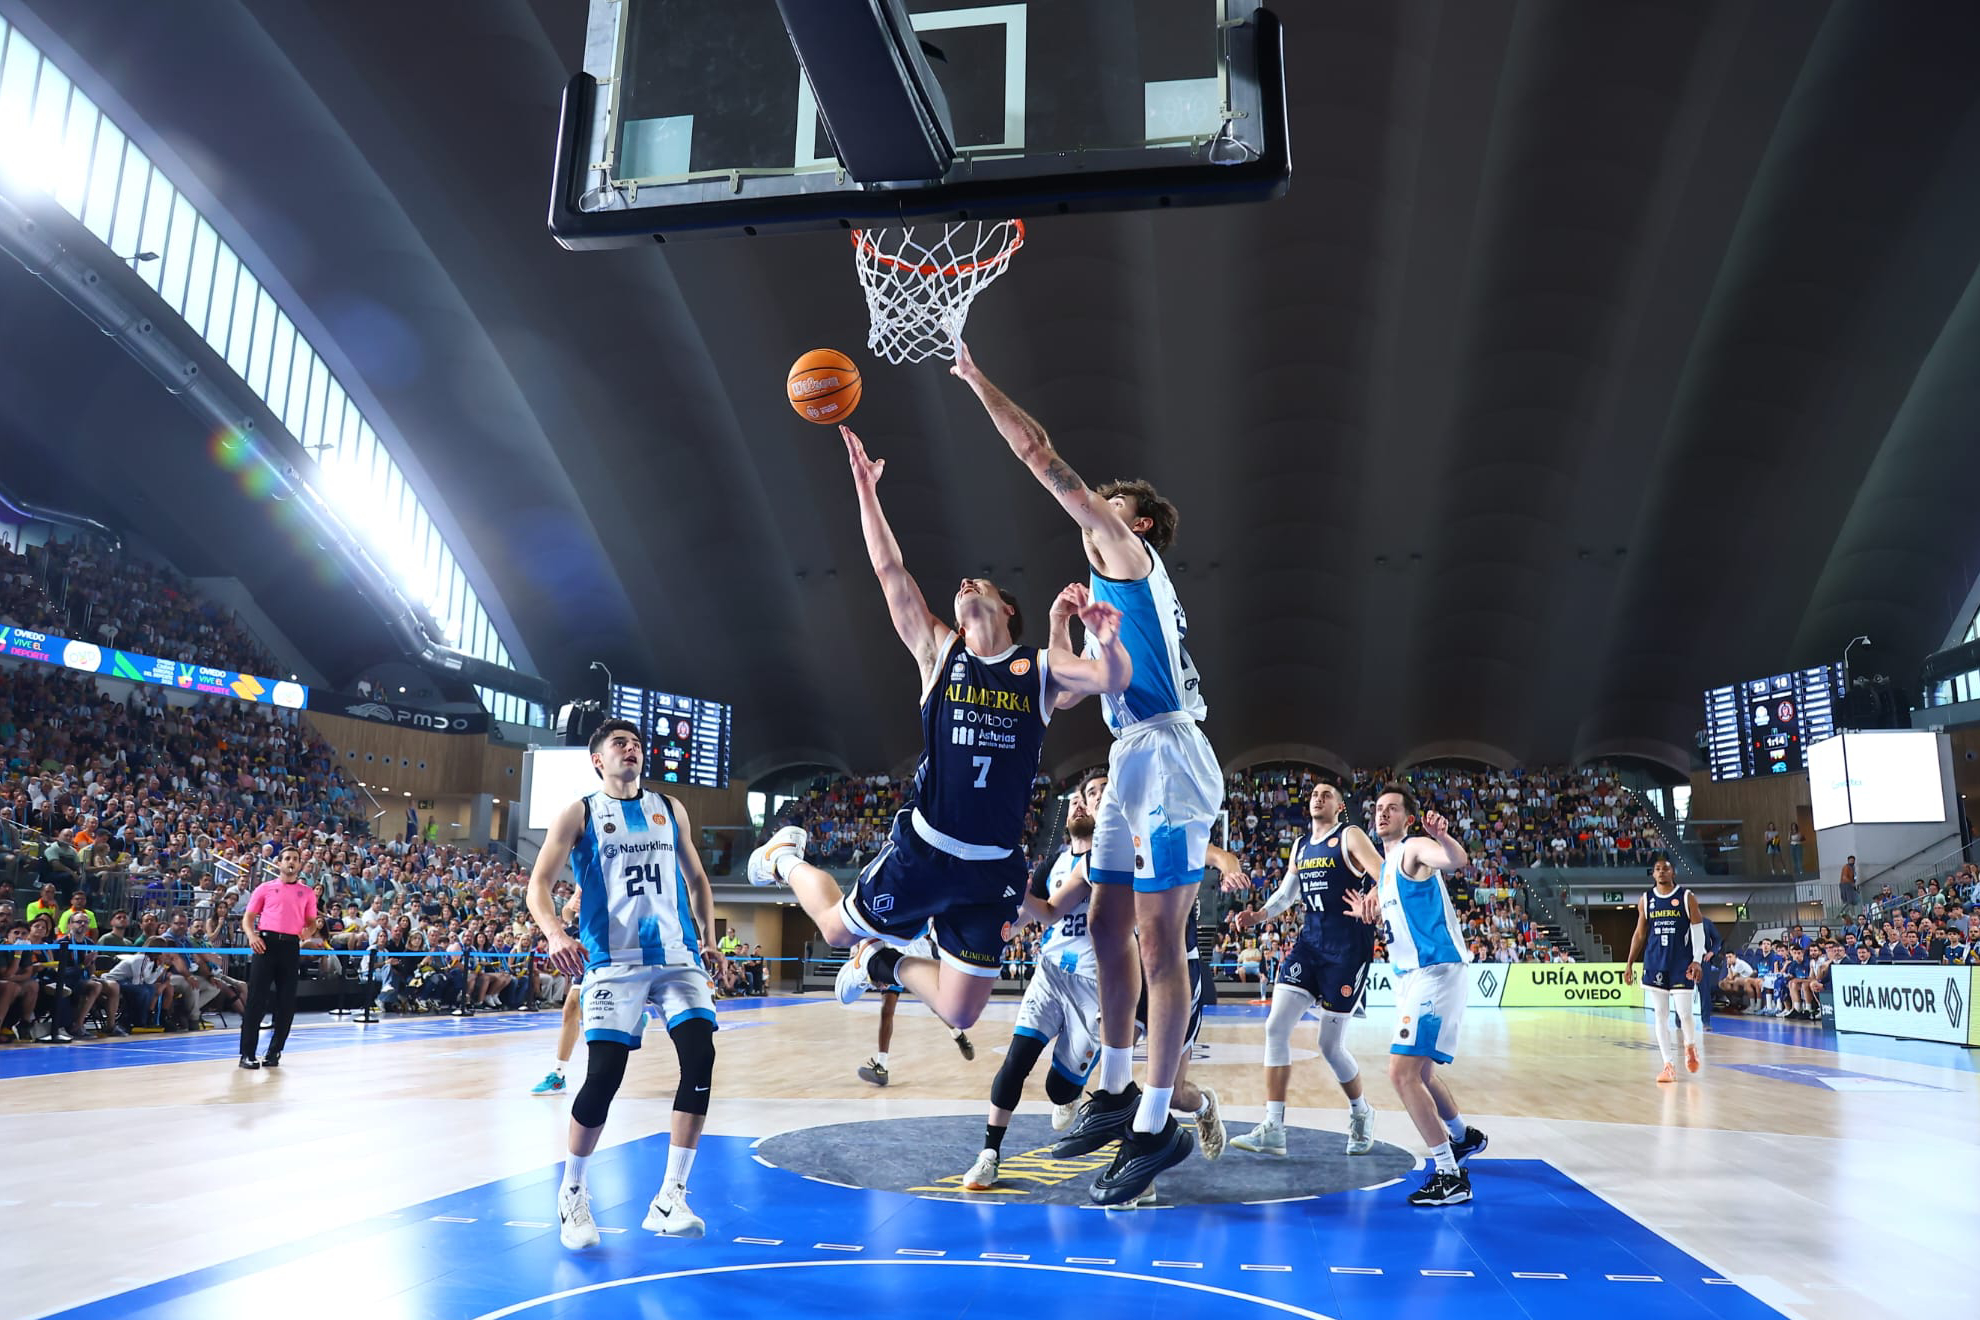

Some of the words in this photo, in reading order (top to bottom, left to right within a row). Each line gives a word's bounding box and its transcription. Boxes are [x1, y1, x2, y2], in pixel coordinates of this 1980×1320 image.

[14, 629, 46, 642] OVIEDO
[13, 638, 32, 649] VIVE
[32, 642, 42, 651] EL
[198, 675, 215, 685] VIVE
[199, 667, 227, 678] OVIEDO
[945, 683, 1031, 714] ALIMERKA
[967, 710, 1013, 729] OVIEDO
[978, 728, 1016, 743] Asturias
[972, 755, 992, 788] 7
[620, 840, 673, 854] Naturklima
[625, 863, 662, 898] 24
[1307, 894, 1325, 912] 14
[1061, 913, 1087, 937] 22
[1365, 973, 1392, 990] RÍA
[1532, 967, 1579, 985] URÍA
[1583, 970, 1638, 985] MOTR
[1564, 989, 1622, 1000] OVIEDO
[1842, 980, 1876, 1009] URÍA
[1878, 986, 1937, 1014] MOTOR
